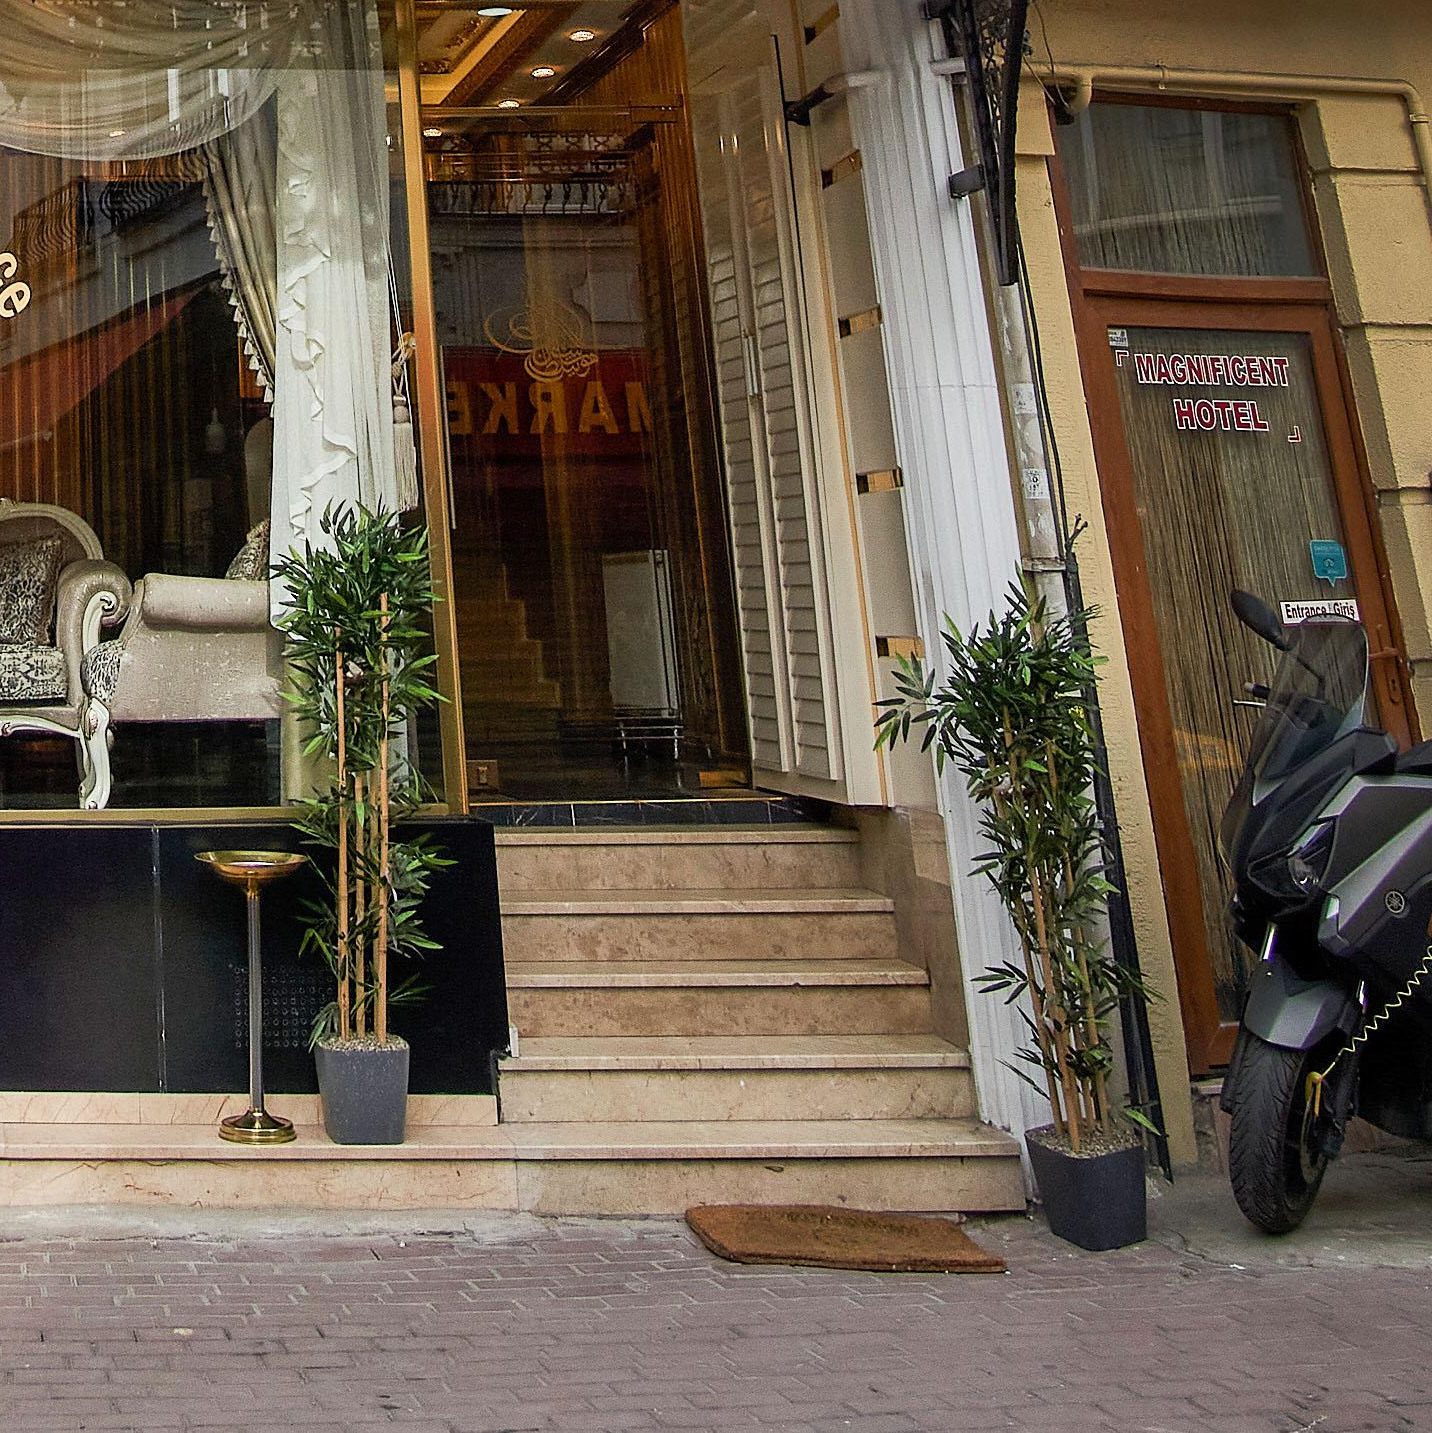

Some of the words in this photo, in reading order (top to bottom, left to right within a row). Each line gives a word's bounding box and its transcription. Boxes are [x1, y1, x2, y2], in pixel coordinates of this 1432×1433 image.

[1134, 353, 1289, 387] MAGNIFICENT
[1172, 398, 1270, 432] HOTEL
[1284, 603, 1327, 619] Entrance
